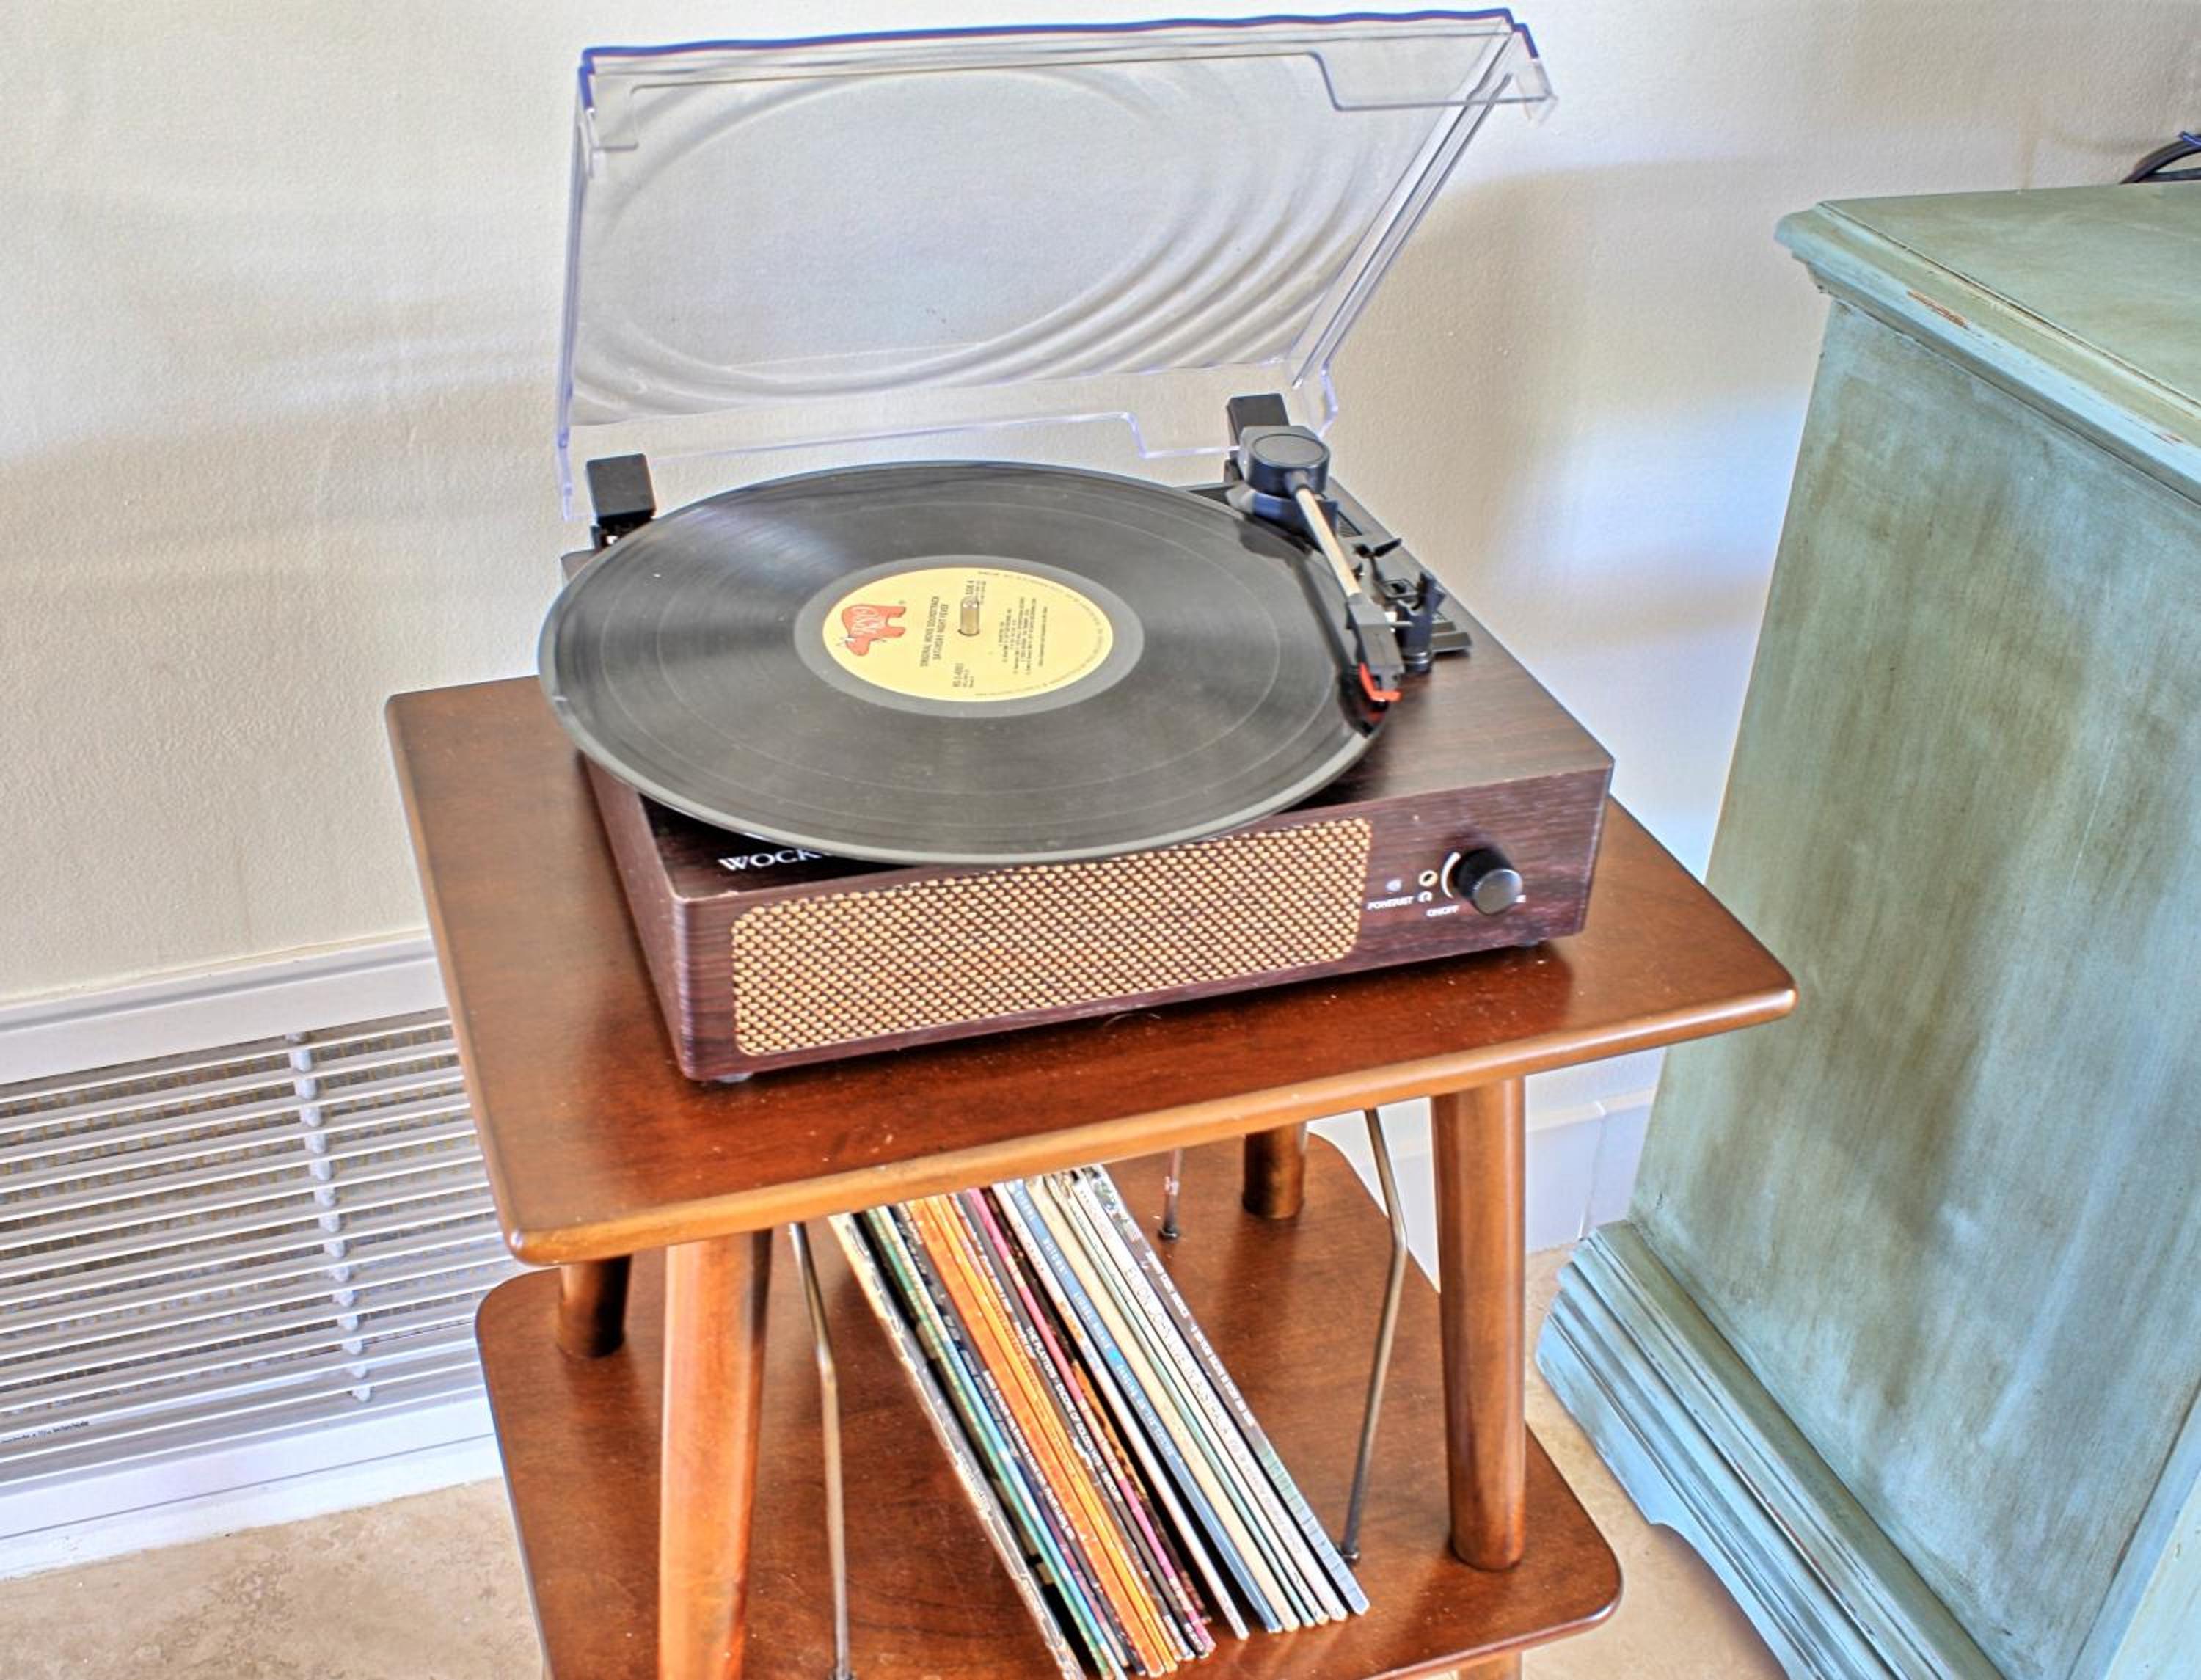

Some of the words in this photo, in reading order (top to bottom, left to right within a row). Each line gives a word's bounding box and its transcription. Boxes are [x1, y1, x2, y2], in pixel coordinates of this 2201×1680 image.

[926, 596, 940, 627] SOUNDTRACK
[938, 604, 949, 618] FEVER
[924, 627, 935, 643] MOVIE
[936, 619, 947, 633] NIGHT
[919, 644, 932, 667] ORIGINAL
[932, 635, 944, 660] SATURDAY
[718, 848, 833, 871] WOCK
[1123, 1266, 1153, 1306] ELTON
[1147, 1304, 1174, 1340] JOHN
[1024, 1325, 1038, 1343] THE
[1032, 1340, 1058, 1379] PLATTERS
[1054, 1382, 1076, 1413] ENCORE
[1074, 1421, 1095, 1452] GOLDEN
[1089, 1449, 1103, 1467] HITS
[1100, 1469, 1123, 1504] MERCURY
